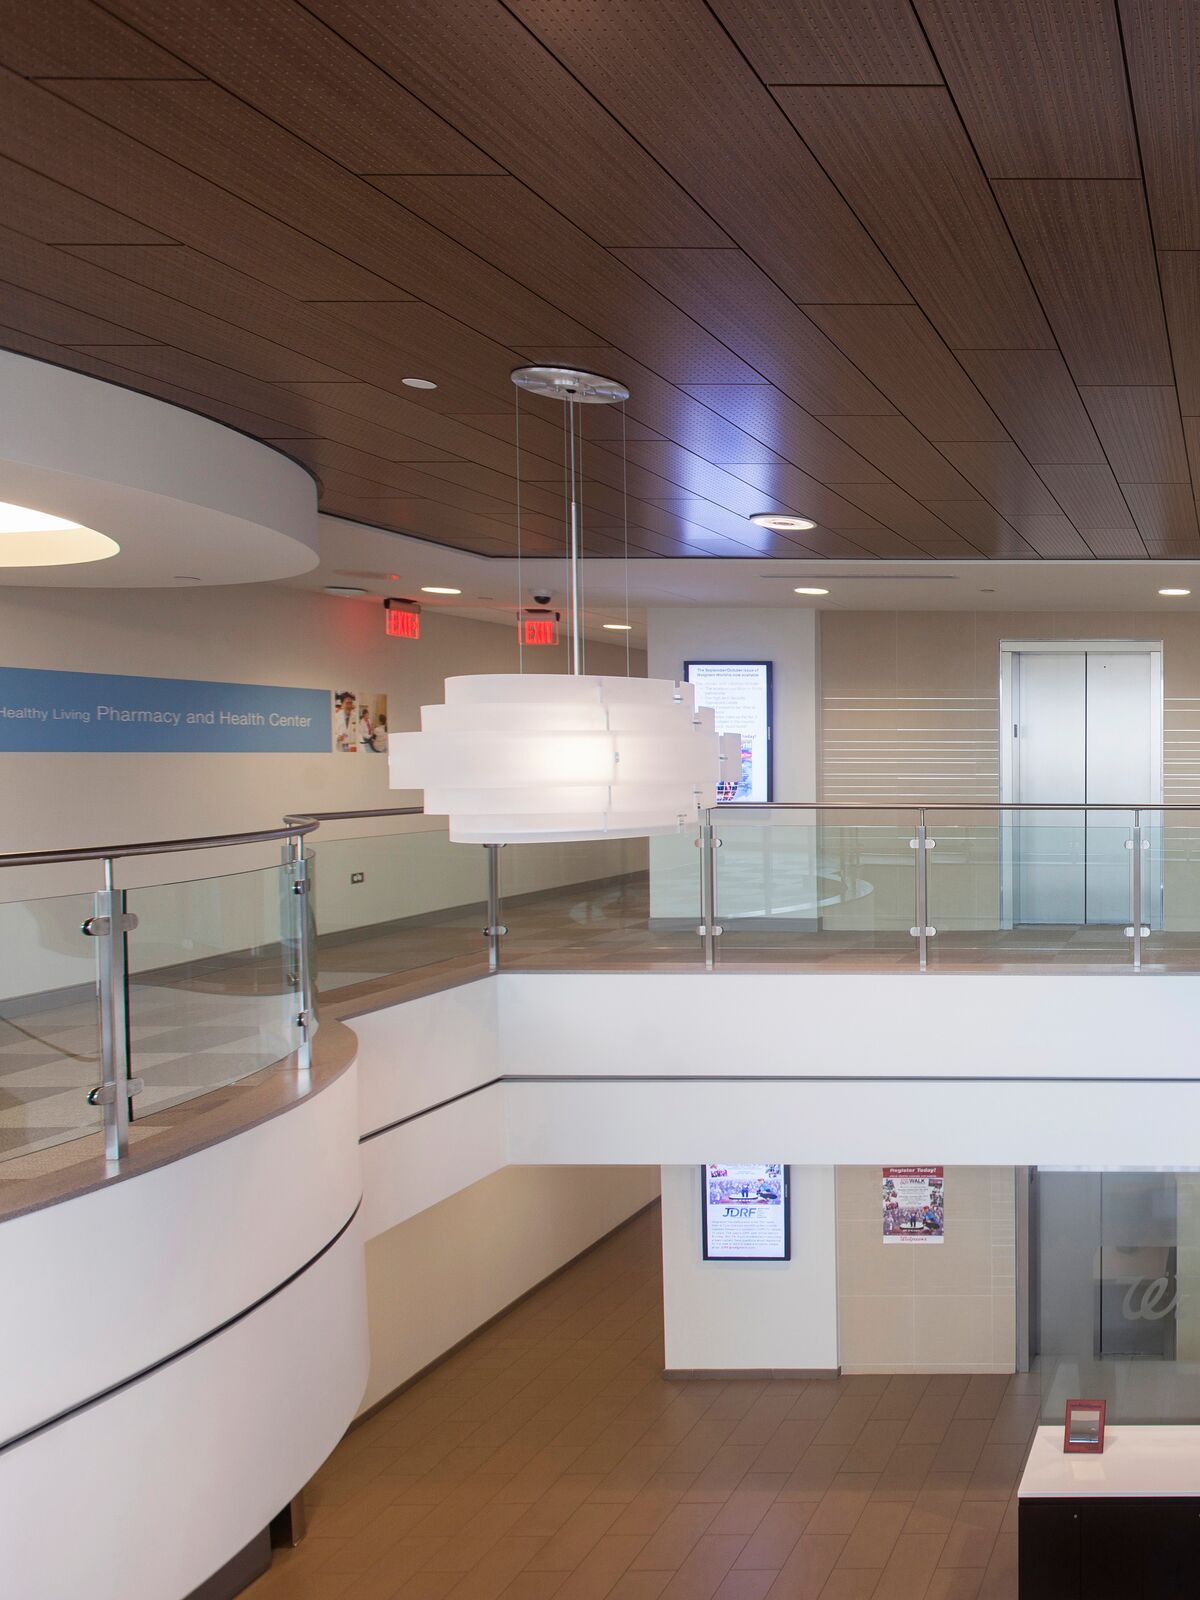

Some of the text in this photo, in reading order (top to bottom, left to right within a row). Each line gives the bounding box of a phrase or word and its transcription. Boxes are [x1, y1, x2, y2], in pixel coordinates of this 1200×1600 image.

[388, 610, 418, 639] EXIT
[525, 621, 553, 645] EXIT
[0, 705, 312, 728] Healthy Living Pharmacy and Health Center
[722, 1207, 757, 1218] JDRF
